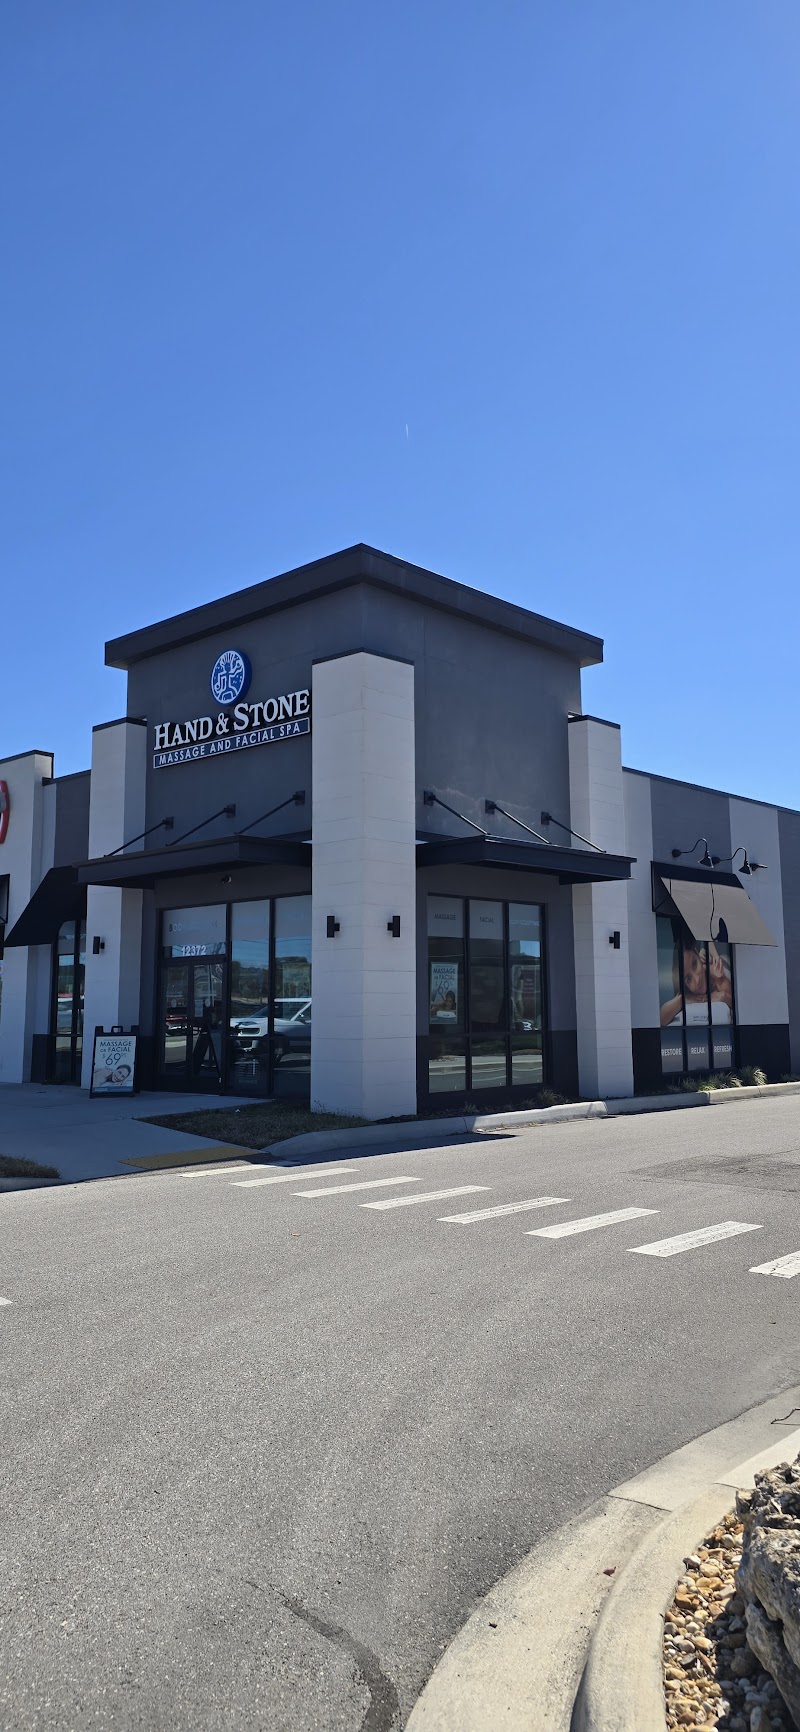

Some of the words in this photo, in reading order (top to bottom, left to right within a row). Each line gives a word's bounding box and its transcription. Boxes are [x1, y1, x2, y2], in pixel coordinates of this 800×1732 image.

[153, 716, 213, 750] HAND
[215, 712, 230, 735] &
[233, 689, 310, 731] STONE
[158, 745, 205, 765] MASSAGE
[209, 737, 231, 753] AND
[235, 730, 274, 748] FACIAL
[279, 722, 301, 737] SPA
[181, 945, 207, 956] 12372
[661, 1047, 682, 1056] RESTORE
[690, 1046, 706, 1054] RELAX
[713, 1045, 732, 1053] REFRESH
